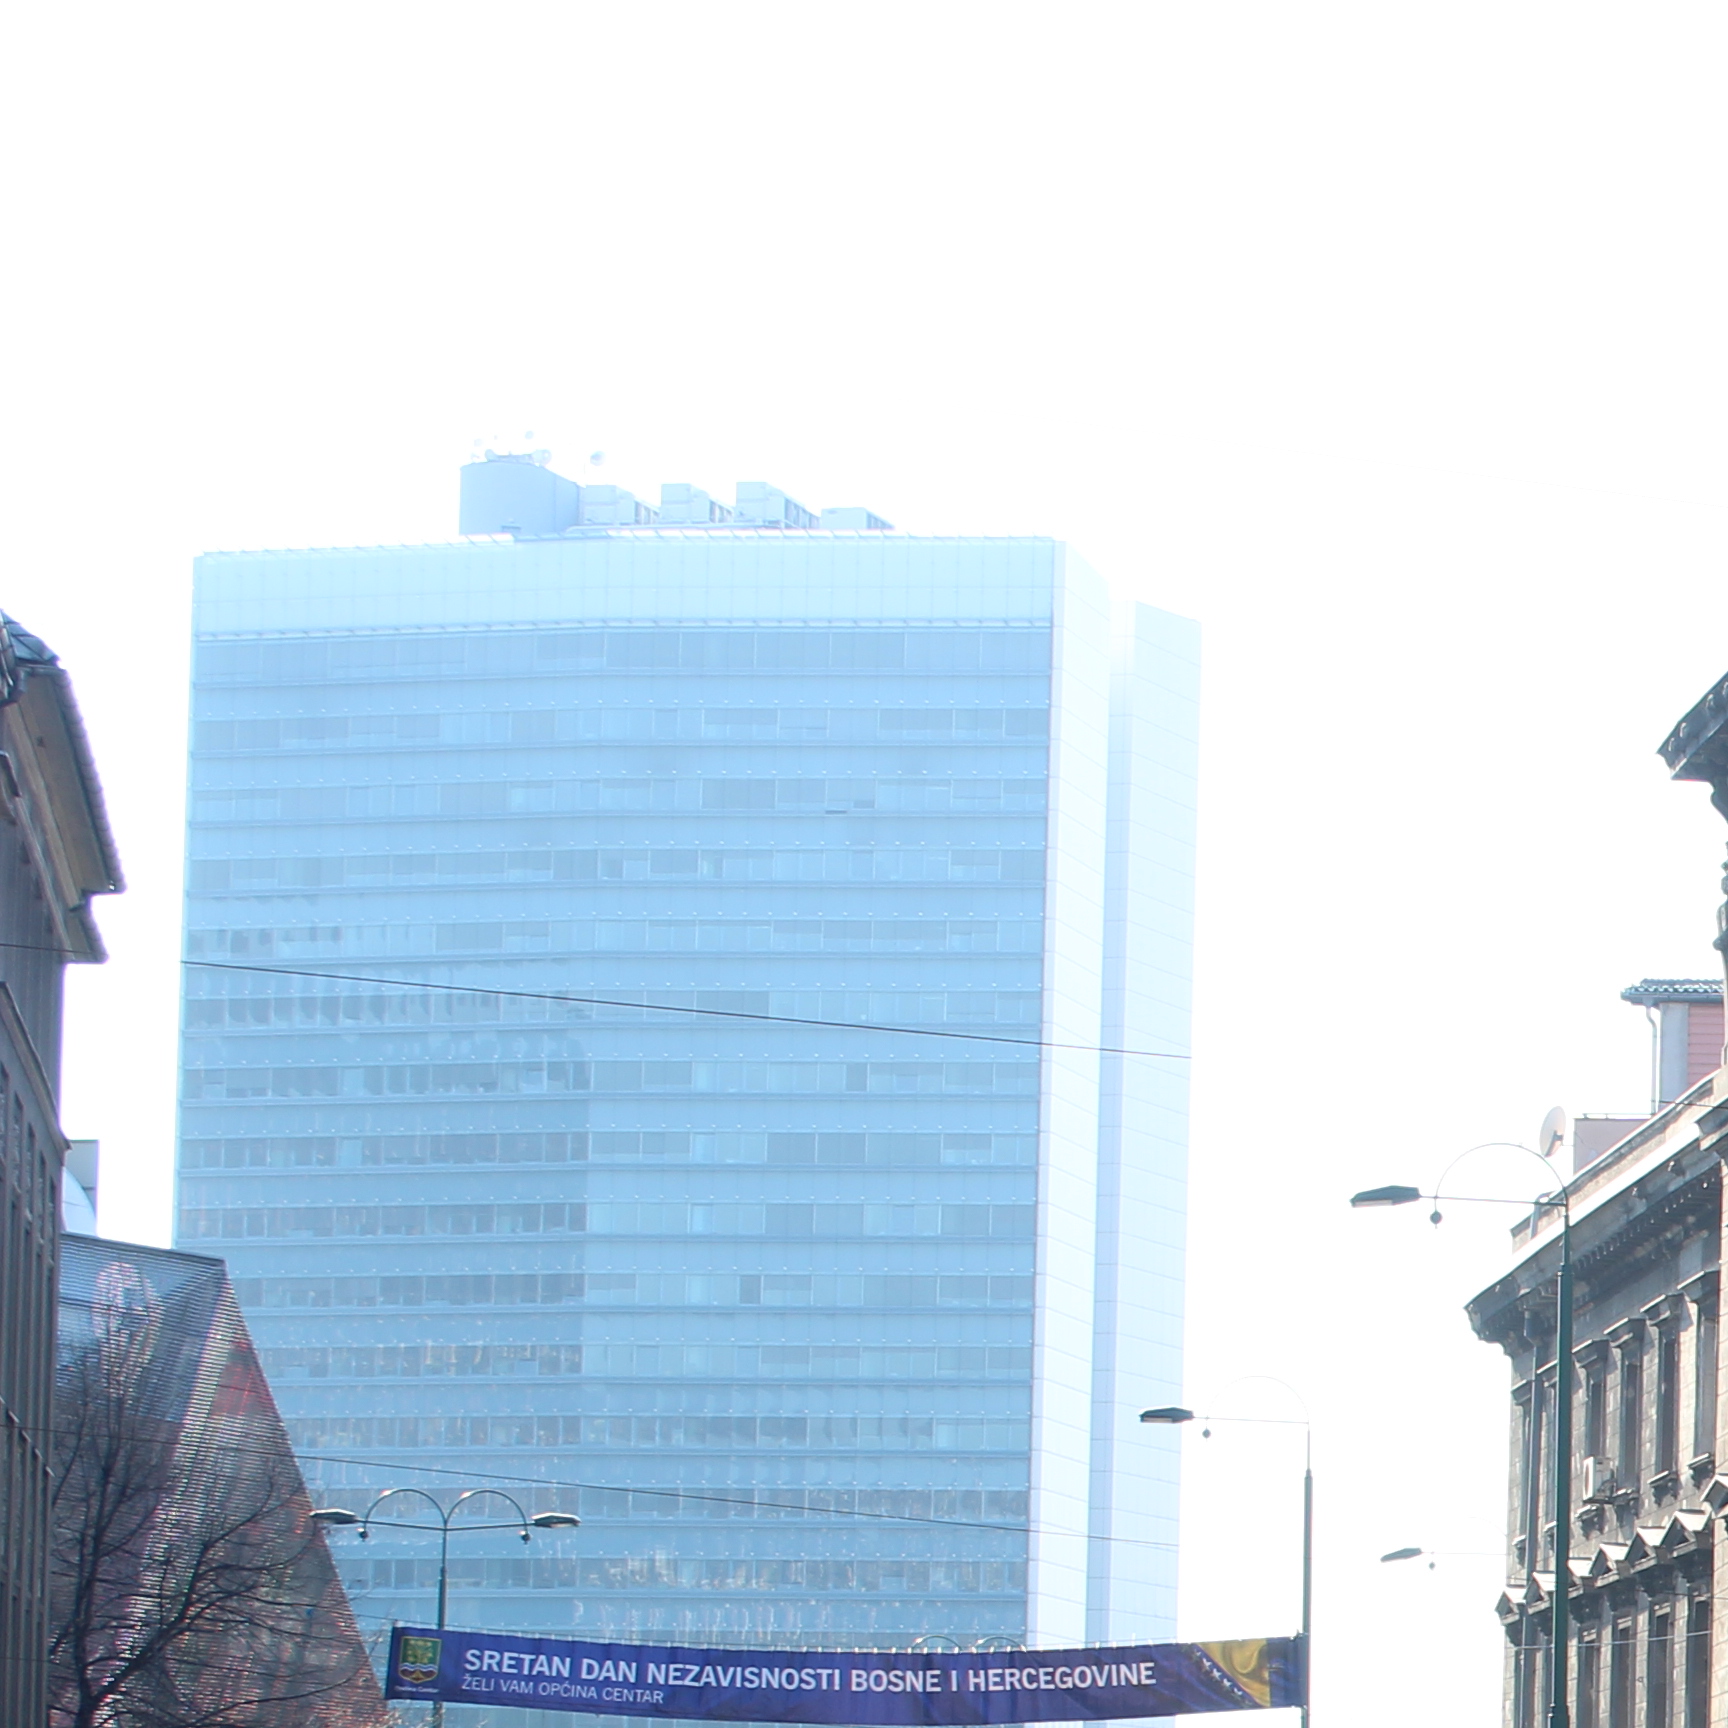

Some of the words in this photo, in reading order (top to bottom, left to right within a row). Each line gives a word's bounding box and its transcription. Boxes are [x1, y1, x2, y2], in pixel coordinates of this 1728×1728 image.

[461, 1672, 494, 1692] ŽELI
[499, 1679, 534, 1695] VAM
[538, 1679, 597, 1700] OPĆINA
[602, 1687, 664, 1704] CENTAR
[464, 1648, 571, 1679] SRETAN
[580, 1659, 638, 1684] DAN
[646, 1662, 841, 1692] NEZAVISNOSTI
[850, 1668, 942, 1692] BOSNE
[951, 1669, 958, 1692] I
[968, 1662, 1157, 1692] HERCEGOVINE
